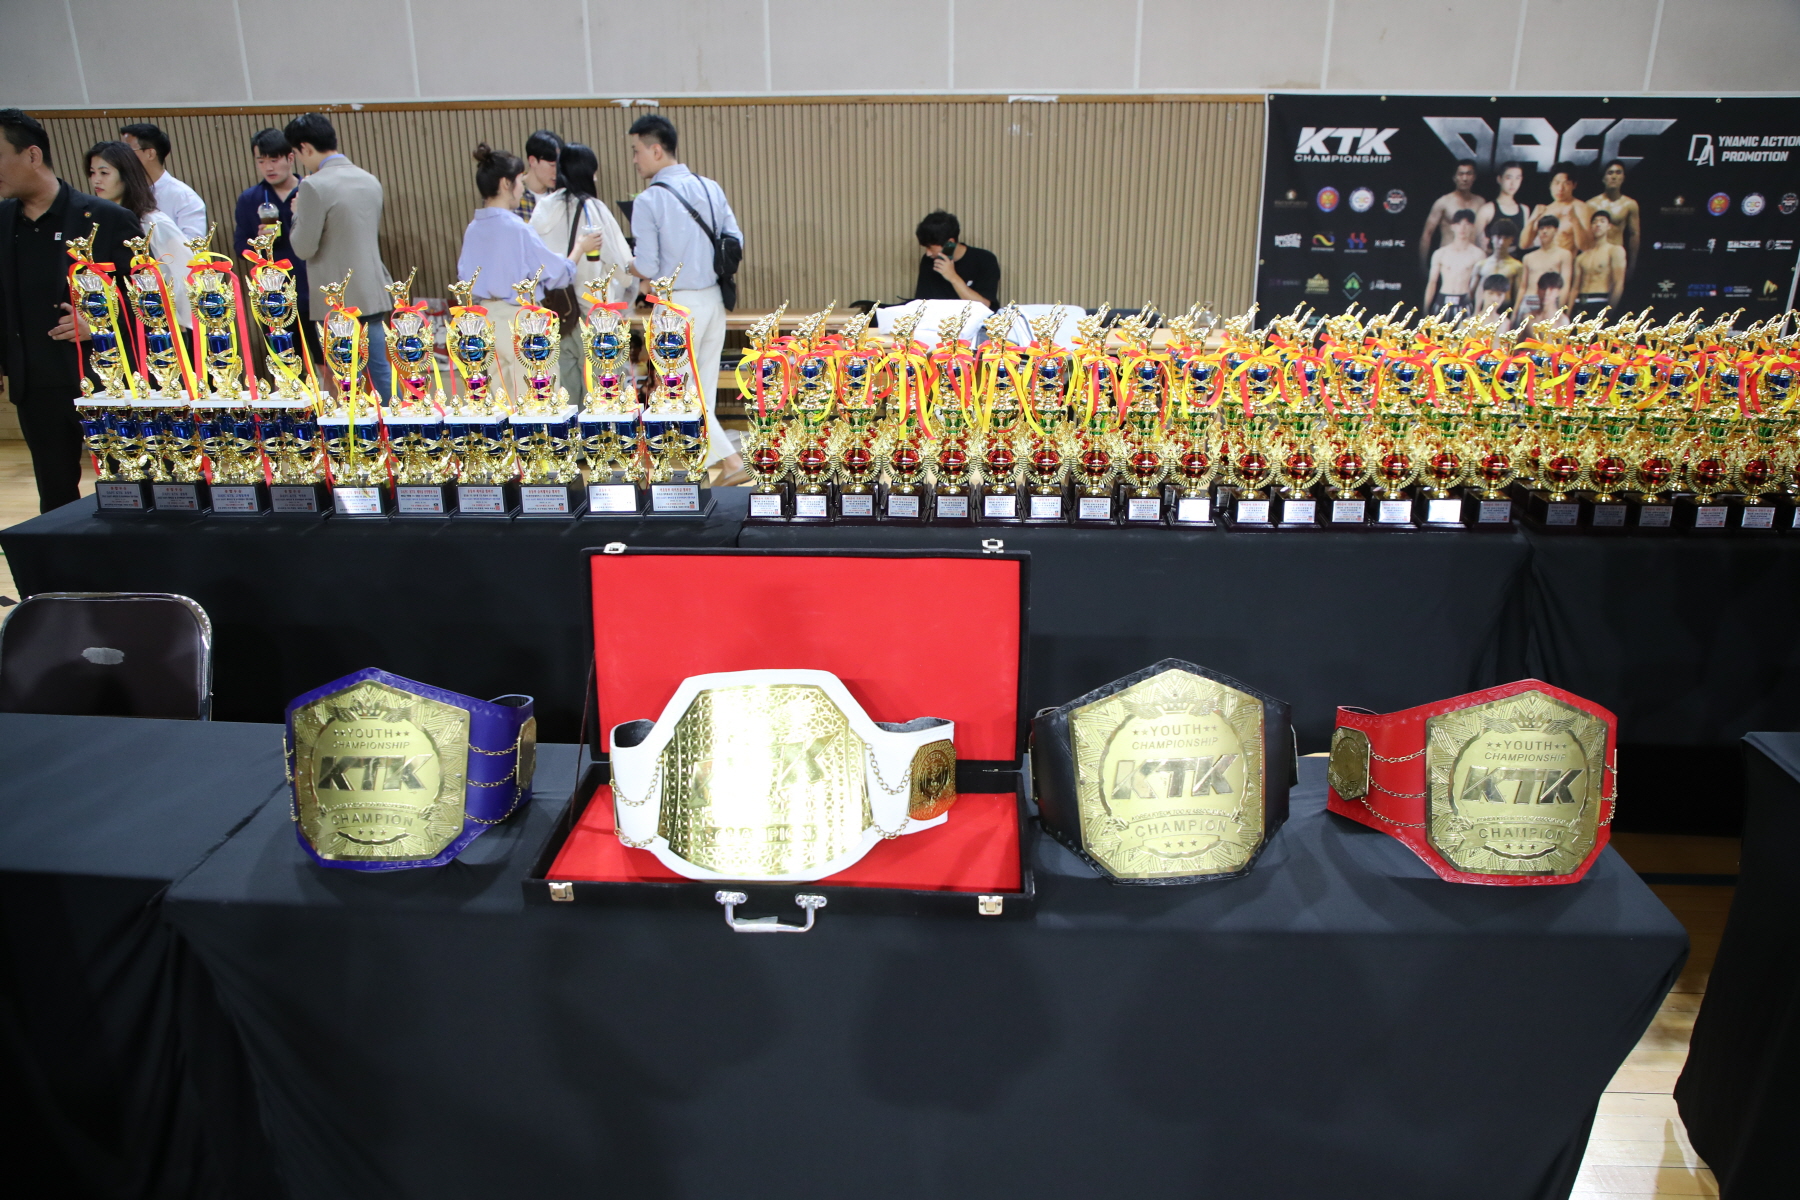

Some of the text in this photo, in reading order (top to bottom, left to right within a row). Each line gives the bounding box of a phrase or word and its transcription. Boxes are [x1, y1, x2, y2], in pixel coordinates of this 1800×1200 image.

[1295, 127, 1400, 155] KTK
[1294, 154, 1392, 163] CHAMPIONSHIP
[1721, 151, 1789, 162] PROMOTION
[348, 728, 393, 738] YOUTH
[1150, 724, 1201, 737] YOUTH
[333, 741, 410, 750] CHAMPIONSHIP
[1132, 737, 1219, 750] CHAMPIONSHIP
[1503, 740, 1552, 751] YOUTH
[1484, 752, 1567, 762] CHAMPIONSHIP
[317, 754, 434, 791] KTK
[1111, 754, 1239, 800] KTK
[1461, 765, 1585, 804] KTK
[332, 812, 414, 826] CHAMPION
[1135, 819, 1227, 837] CHAMPION
[1478, 827, 1564, 840] CHAMPION
